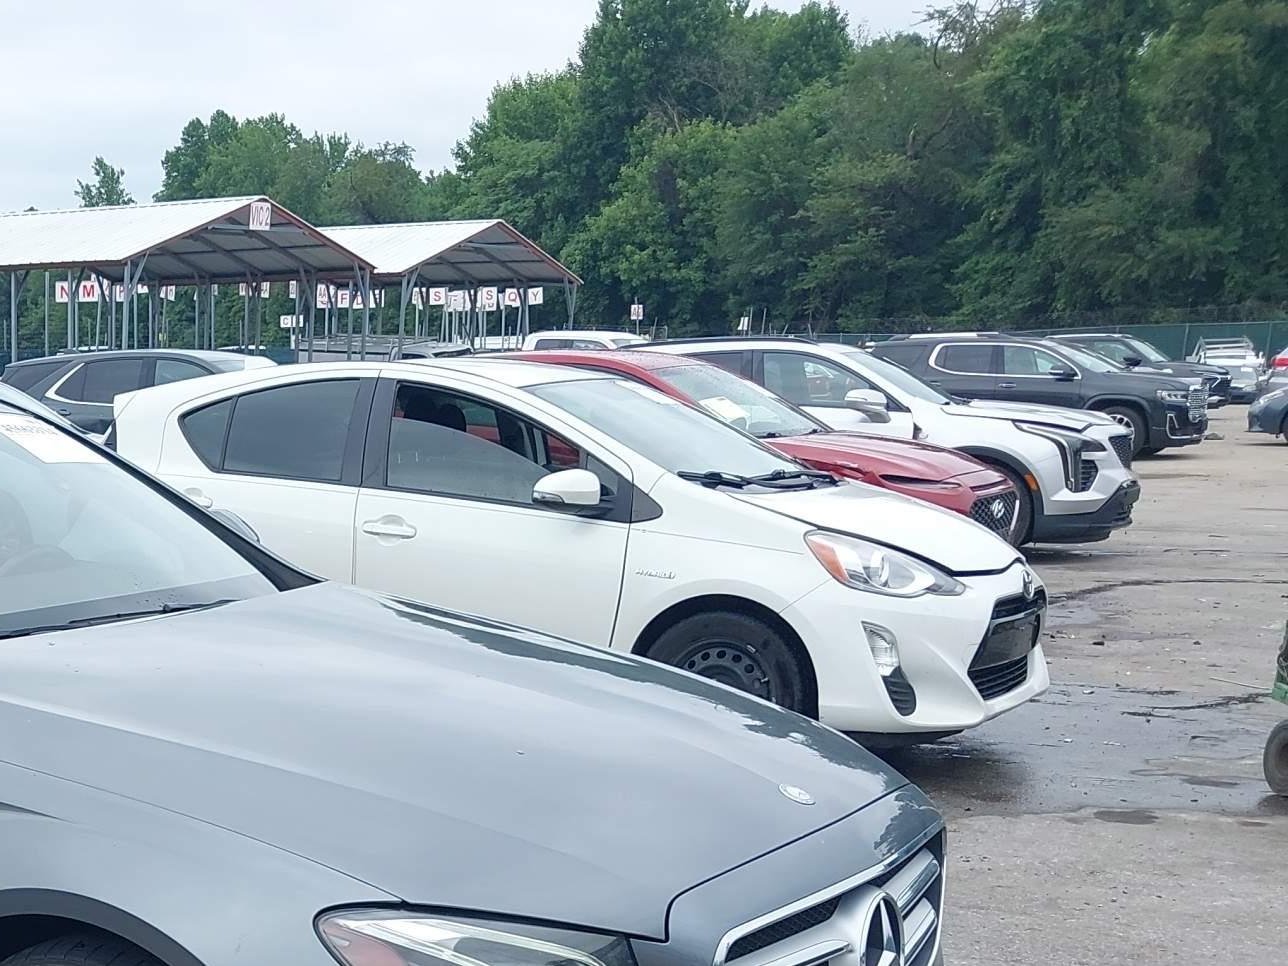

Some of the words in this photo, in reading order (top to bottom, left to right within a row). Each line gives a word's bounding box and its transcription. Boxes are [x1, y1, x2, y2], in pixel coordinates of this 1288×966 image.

[82, 285, 95, 298] M
[433, 291, 442, 302] S
[486, 289, 494, 301] S
[508, 291, 518, 303] Q
[531, 291, 540, 302] Y
